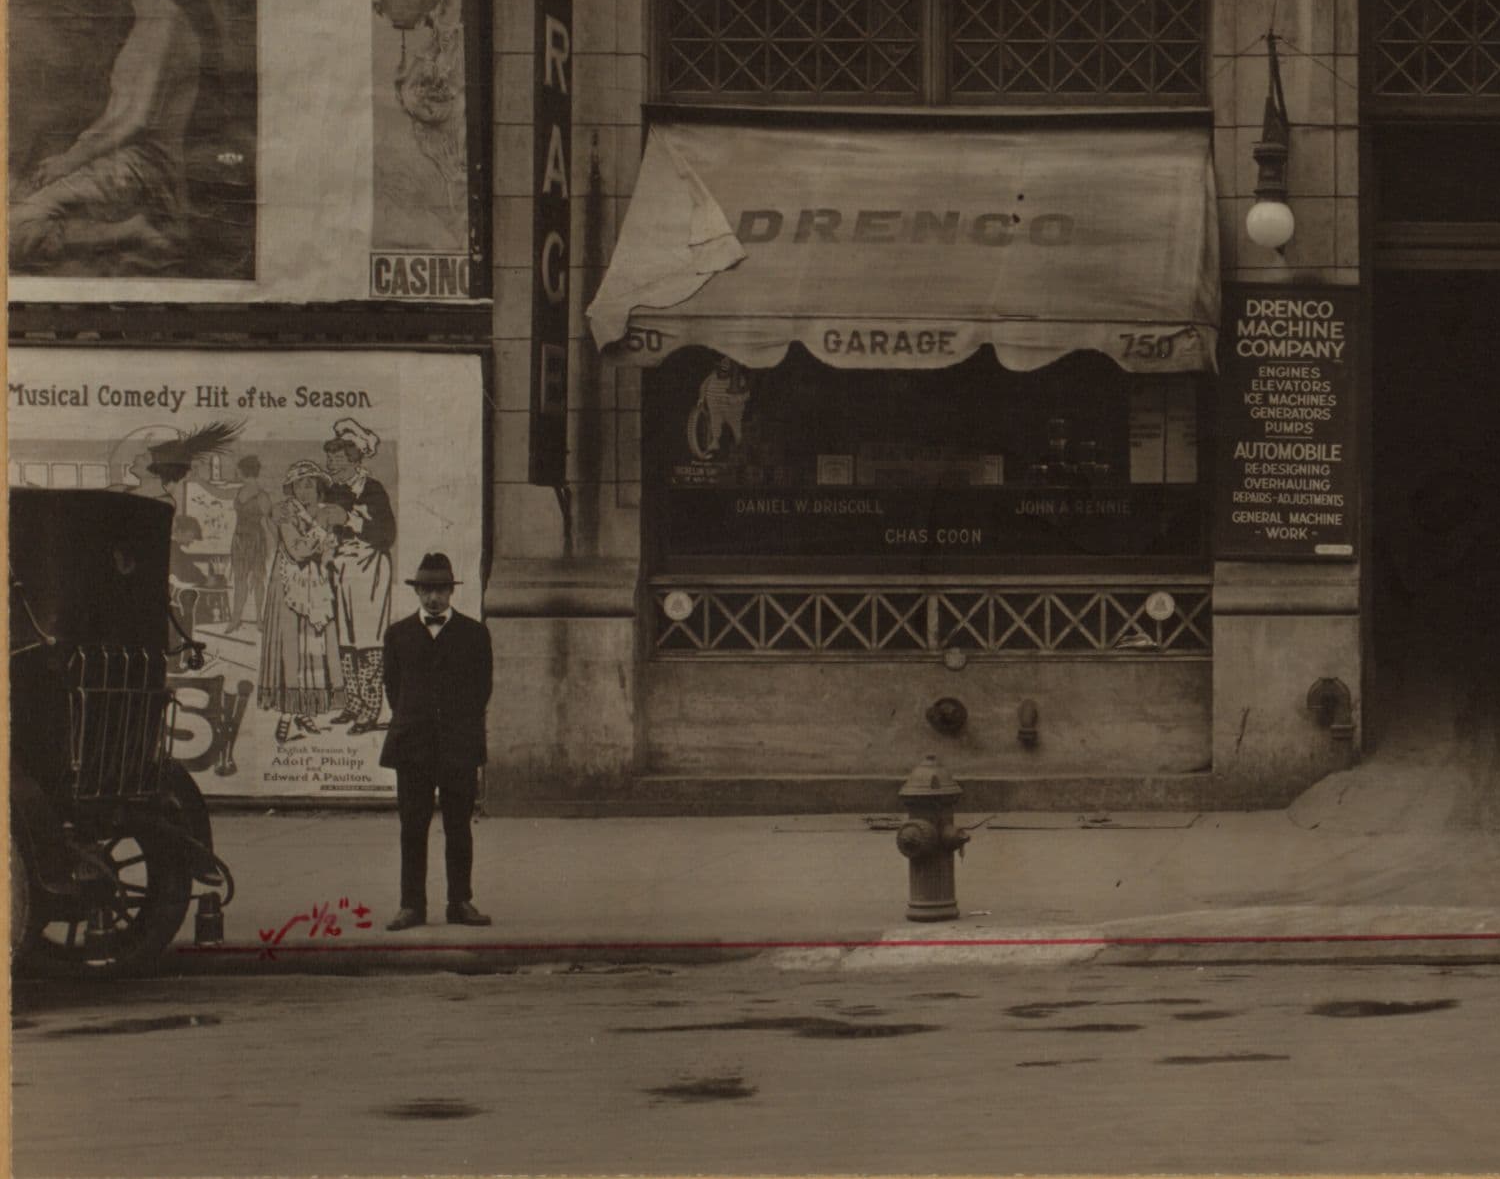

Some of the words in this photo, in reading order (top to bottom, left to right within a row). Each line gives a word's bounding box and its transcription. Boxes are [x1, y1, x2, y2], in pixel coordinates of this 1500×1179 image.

[736, 208, 1076, 248] DRENCO
[1246, 299, 1334, 319] DRENCO
[1237, 320, 1345, 339] MACHINE
[823, 328, 957, 357] GARAGE
[1119, 333, 1175, 360] 750
[1236, 339, 1345, 359] COMPANY
[1258, 366, 1321, 380] ENGINES
[1251, 380, 1332, 393] ELEVATORS
[8, 384, 90, 407] Musical
[97, 385, 187, 414] Comedy
[195, 385, 230, 409] Hit
[237, 388, 257, 409] of
[258, 388, 288, 409] the
[295, 385, 373, 409] Season
[1244, 393, 1264, 406] ICE
[1268, 393, 1337, 407] MACHINES
[1250, 407, 1332, 421] GENERATORS
[1264, 421, 1314, 435] PUMPS
[1233, 441, 1343, 462] AUTOMOBILE
[1244, 463, 1331, 477] RE-DESIGNING
[1244, 478, 1332, 492] OVERHAULING
[736, 500, 790, 515] DANIEL
[813, 500, 885, 516] DRISCOLL
[1015, 500, 1055, 516] JOHN
[1231, 511, 1284, 525] GENERAL
[1288, 511, 1343, 526] MACHINE
[884, 527, 928, 544] CHAS
[935, 527, 982, 544] COON
[272, 756, 314, 766] Adolf
[321, 757, 365, 771] Philipp
[263, 773, 309, 782] Edward
